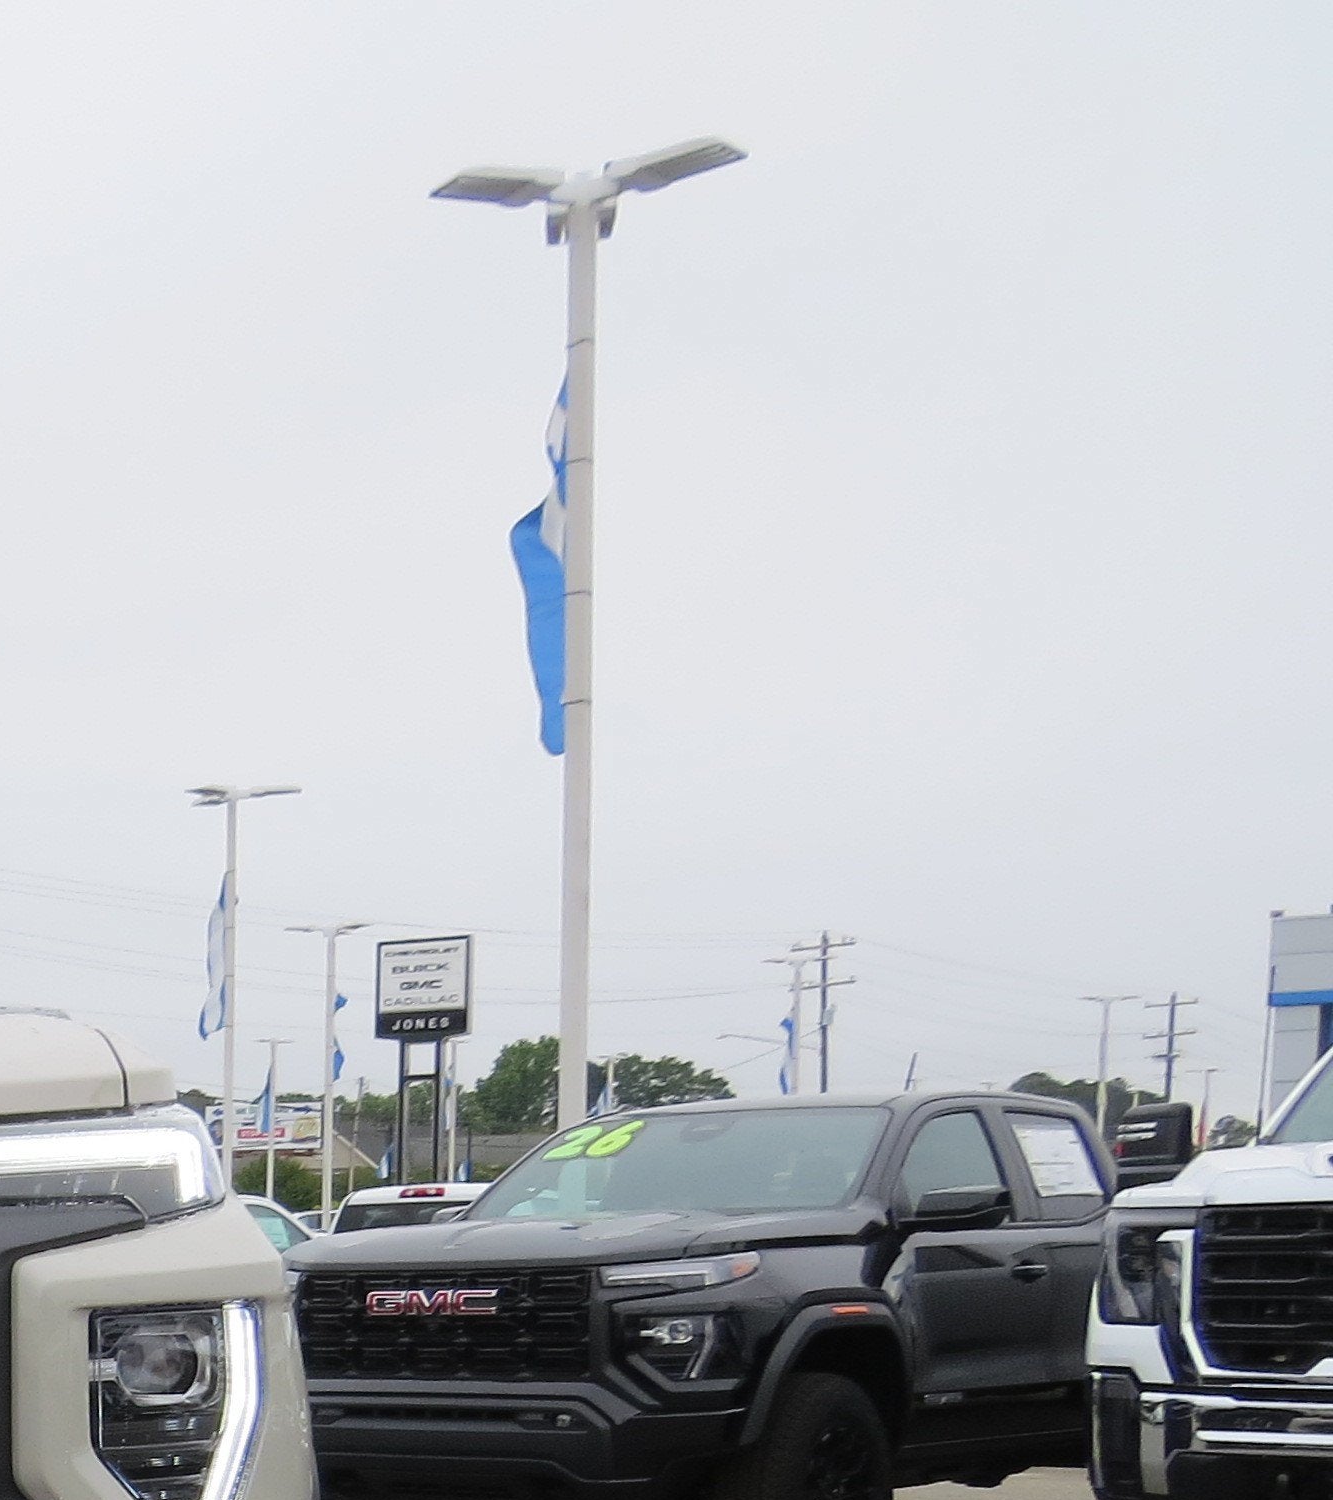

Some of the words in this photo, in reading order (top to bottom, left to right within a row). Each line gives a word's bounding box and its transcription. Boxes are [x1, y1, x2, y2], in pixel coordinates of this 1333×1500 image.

[391, 962, 450, 974] BUICK
[399, 979, 443, 991] GMC
[383, 993, 459, 1006] CADILLAC
[391, 1016, 450, 1031] JONES
[541, 1120, 645, 1161] 26
[365, 1288, 500, 1316] GMC
